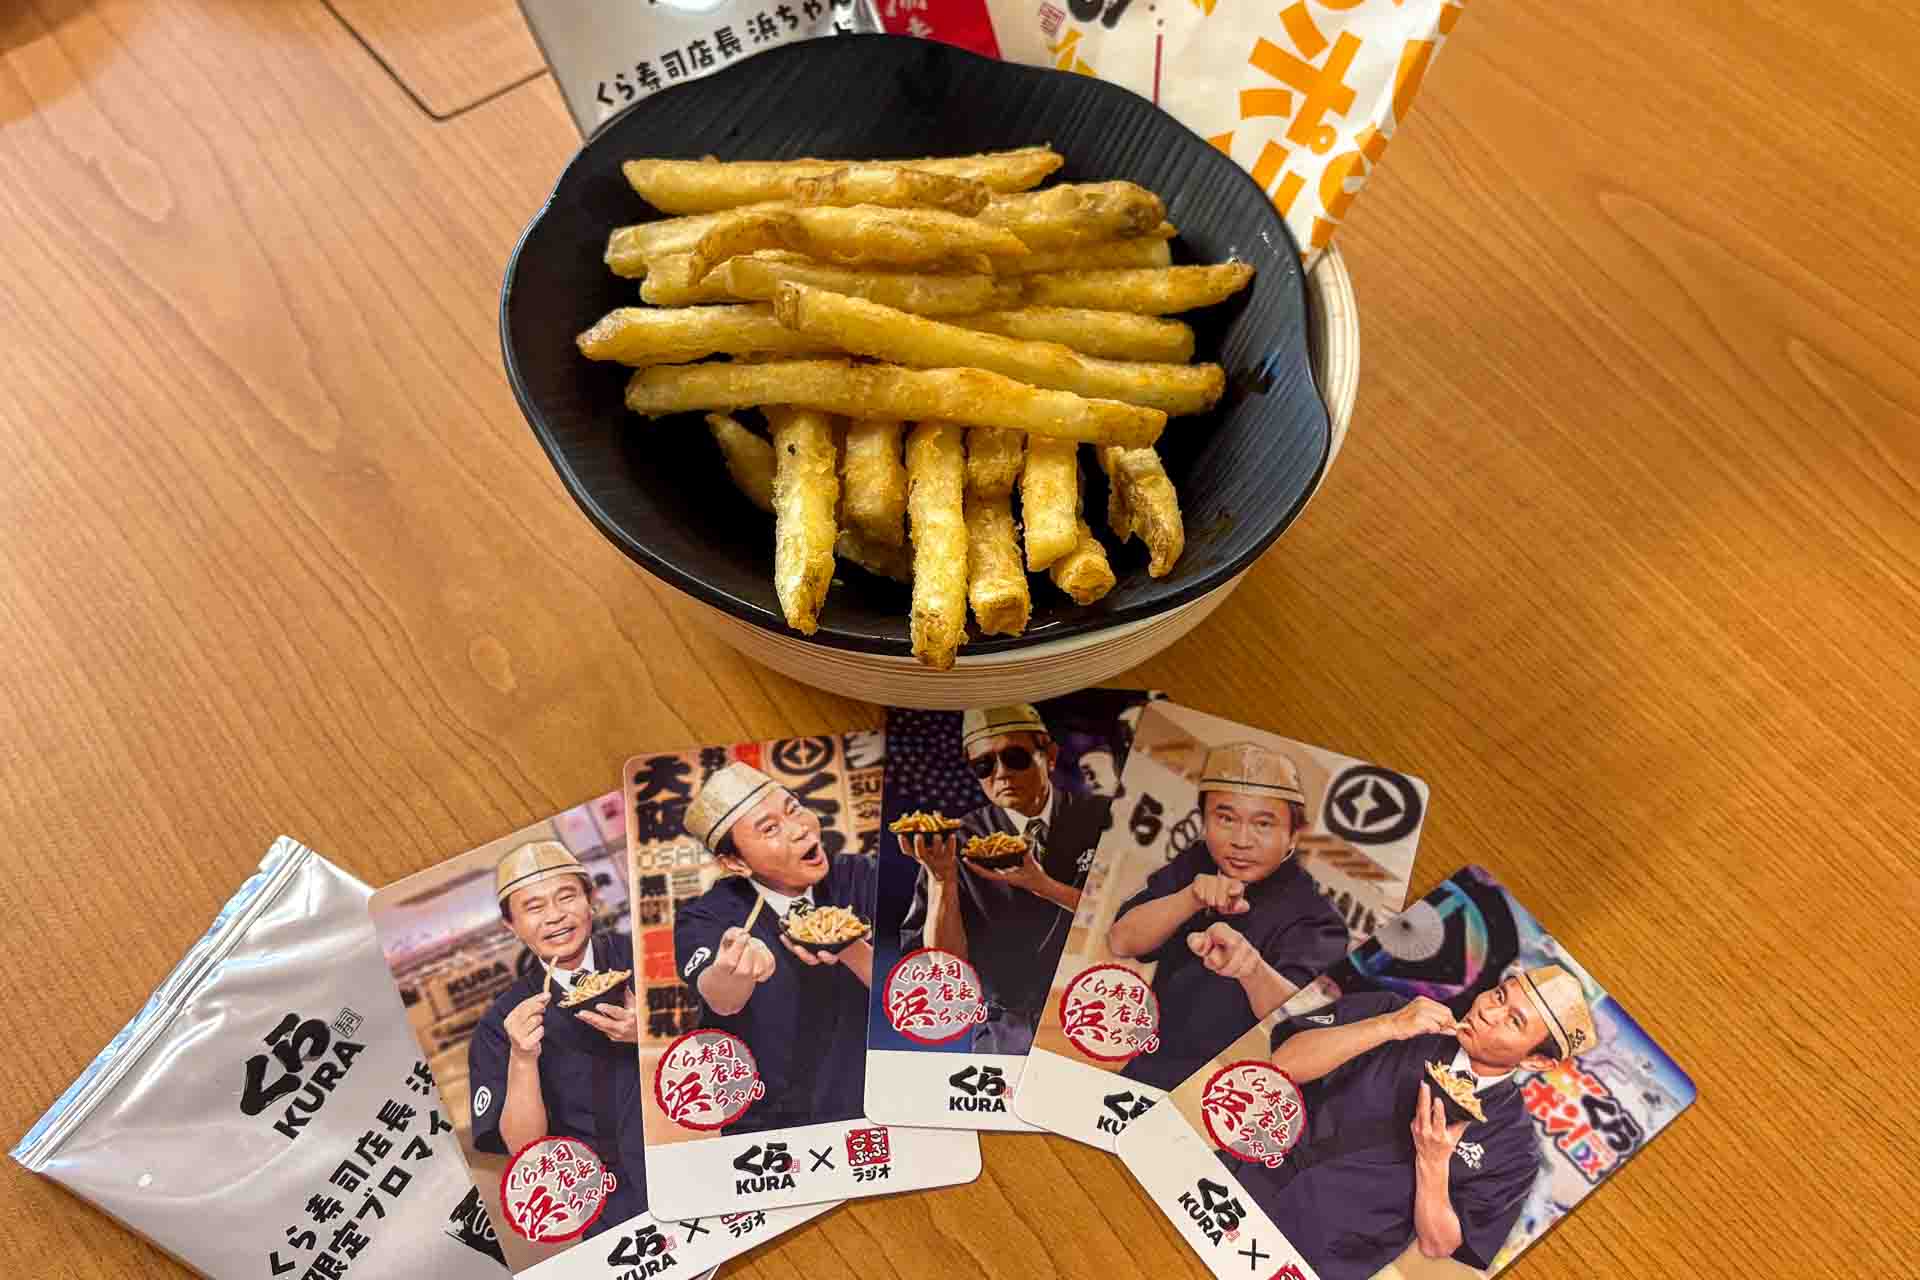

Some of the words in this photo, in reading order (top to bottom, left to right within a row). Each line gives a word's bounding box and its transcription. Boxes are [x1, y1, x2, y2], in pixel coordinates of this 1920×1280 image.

[596, 26, 743, 106] くら寿司店長
[897, 961, 962, 983] くら寿司
[936, 981, 975, 1001] 店長
[1080, 976, 1145, 1005] くら寿司
[1112, 1004, 1152, 1028] 店長
[240, 1013, 331, 1116] くら
[668, 1039, 734, 1070] くら寿司
[709, 1058, 751, 1085] 店長
[949, 1065, 1007, 1096] くら
[273, 1041, 368, 1140] KURA
[949, 1096, 1007, 1113] KURA
[1241, 1068, 1299, 1121] くら寿司
[1096, 1115, 1127, 1136] KU
[509, 1143, 574, 1192] くら寿司
[733, 1142, 793, 1176] くら
[852, 1166, 892, 1183] ラジオ
[269, 1098, 417, 1277] くら寿司店長
[735, 1173, 796, 1195] KURA
[1177, 1191, 1224, 1247] KURA
[1197, 1178, 1246, 1232] くら
[728, 1210, 767, 1239] ラジオ
[607, 1224, 667, 1266] くら
